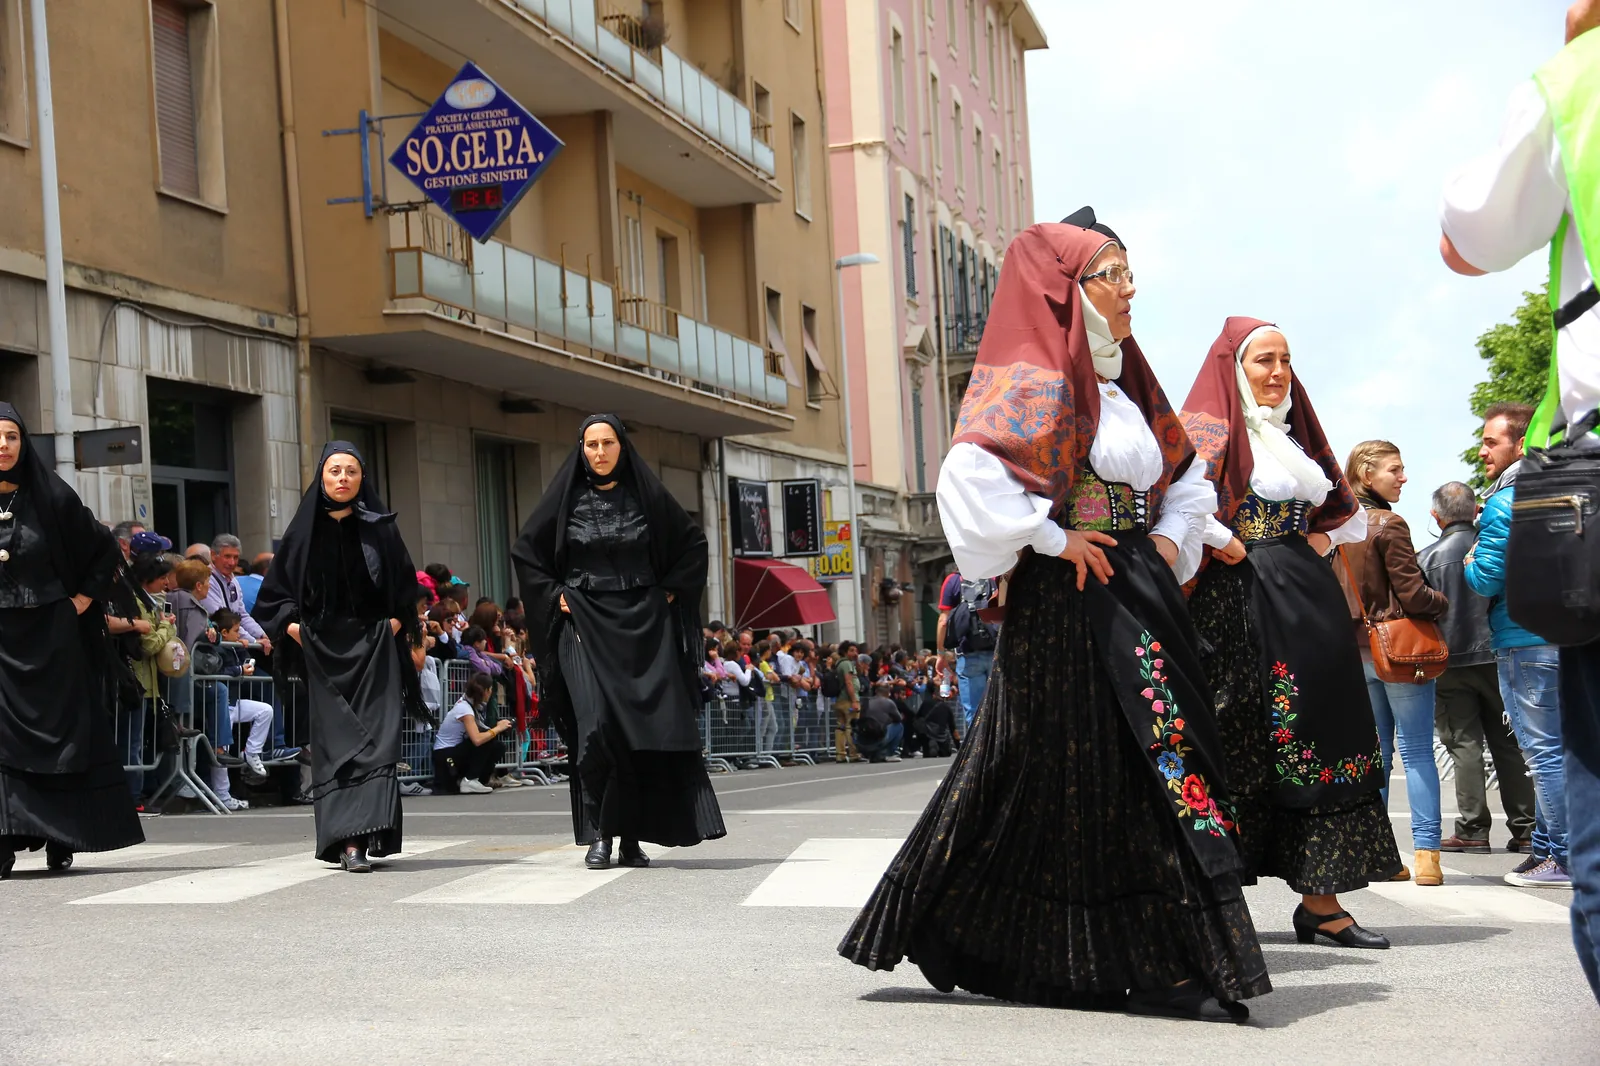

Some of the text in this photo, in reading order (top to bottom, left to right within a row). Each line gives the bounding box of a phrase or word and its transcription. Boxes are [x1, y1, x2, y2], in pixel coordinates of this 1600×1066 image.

[425, 117, 520, 134] PRATICHE ASSICURATIVE
[435, 108, 508, 124] SOCIETA' GESTIONE
[406, 126, 544, 176] SO.GE.P.A.
[424, 168, 528, 189] GESTIONE SINISTRI
